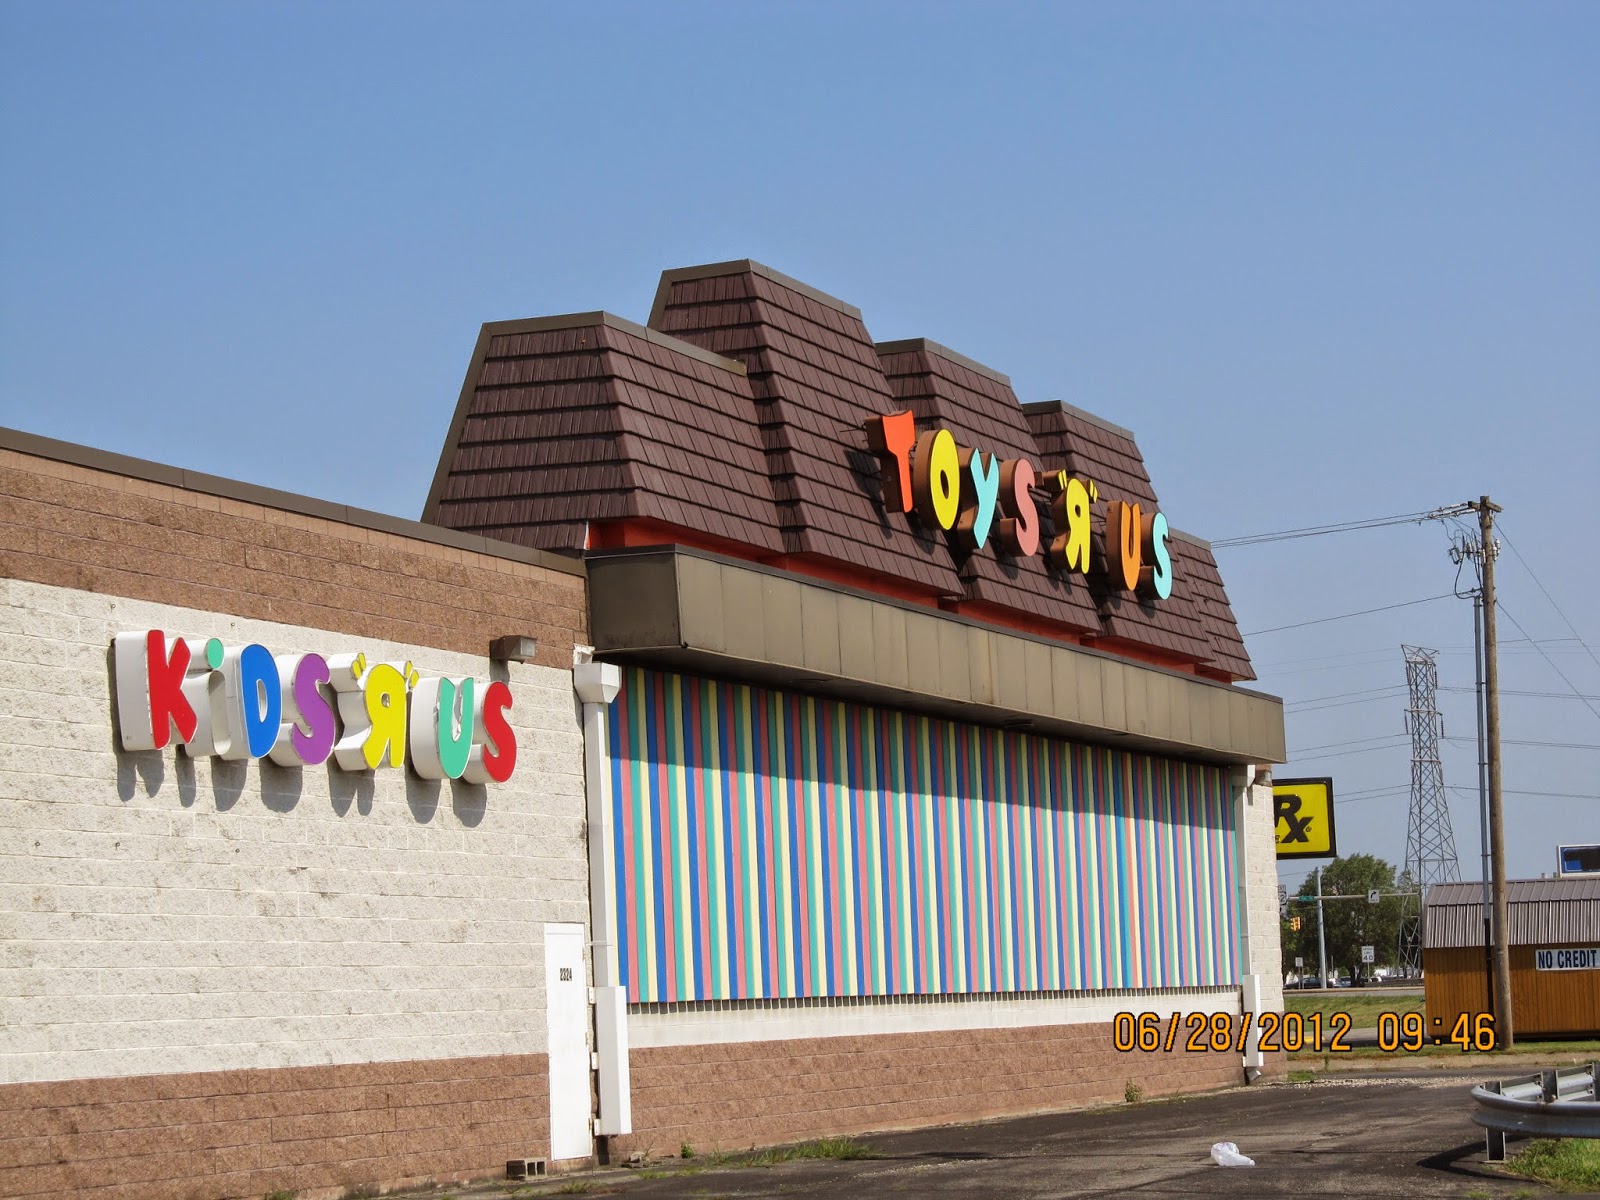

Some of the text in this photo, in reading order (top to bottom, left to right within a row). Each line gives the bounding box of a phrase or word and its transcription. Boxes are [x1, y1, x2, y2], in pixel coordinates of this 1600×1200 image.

[882, 409, 1040, 557] TOYS
[1121, 500, 1173, 600] US
[438, 676, 517, 783] US
[560, 967, 573, 982] 2324
[1538, 949, 1597, 969] NO CREDIT
